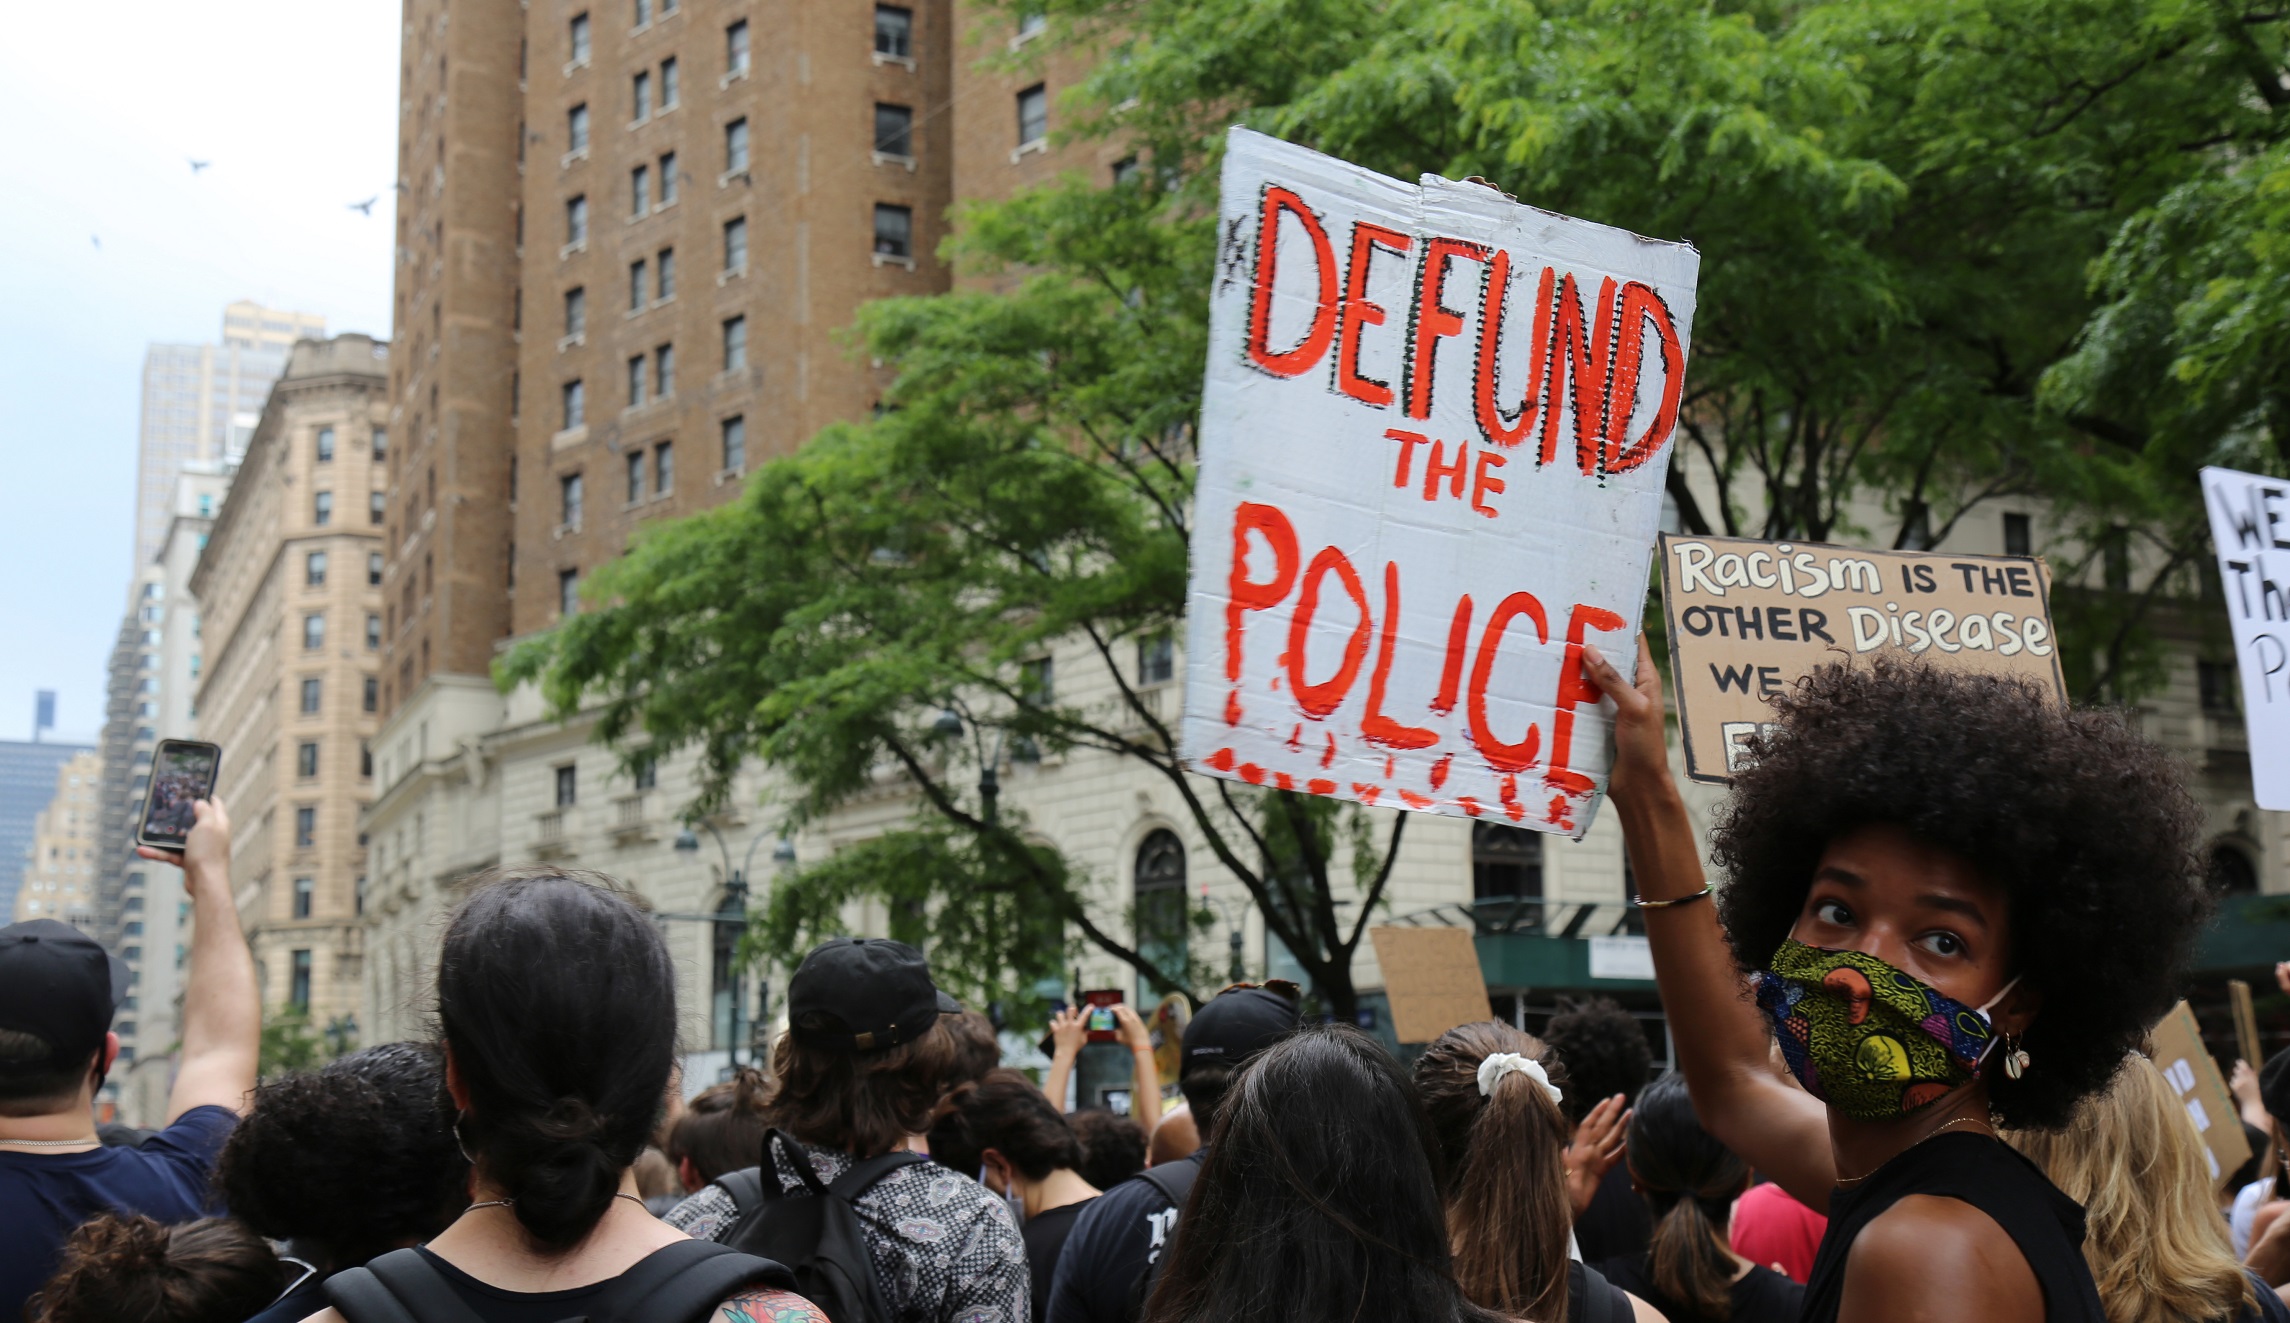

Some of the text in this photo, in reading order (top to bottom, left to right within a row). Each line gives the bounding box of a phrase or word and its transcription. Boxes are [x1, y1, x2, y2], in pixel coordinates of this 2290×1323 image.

[1243, 181, 1685, 489] DEFUND
[1385, 428, 1507, 519] THE
[1672, 541, 2034, 598] Racism IS THE
[2226, 553, 2290, 622] Th
[1223, 501, 1628, 797] POLICE
[1681, 601, 2054, 656] OTHER Disease
[1708, 663, 1785, 695] WE
